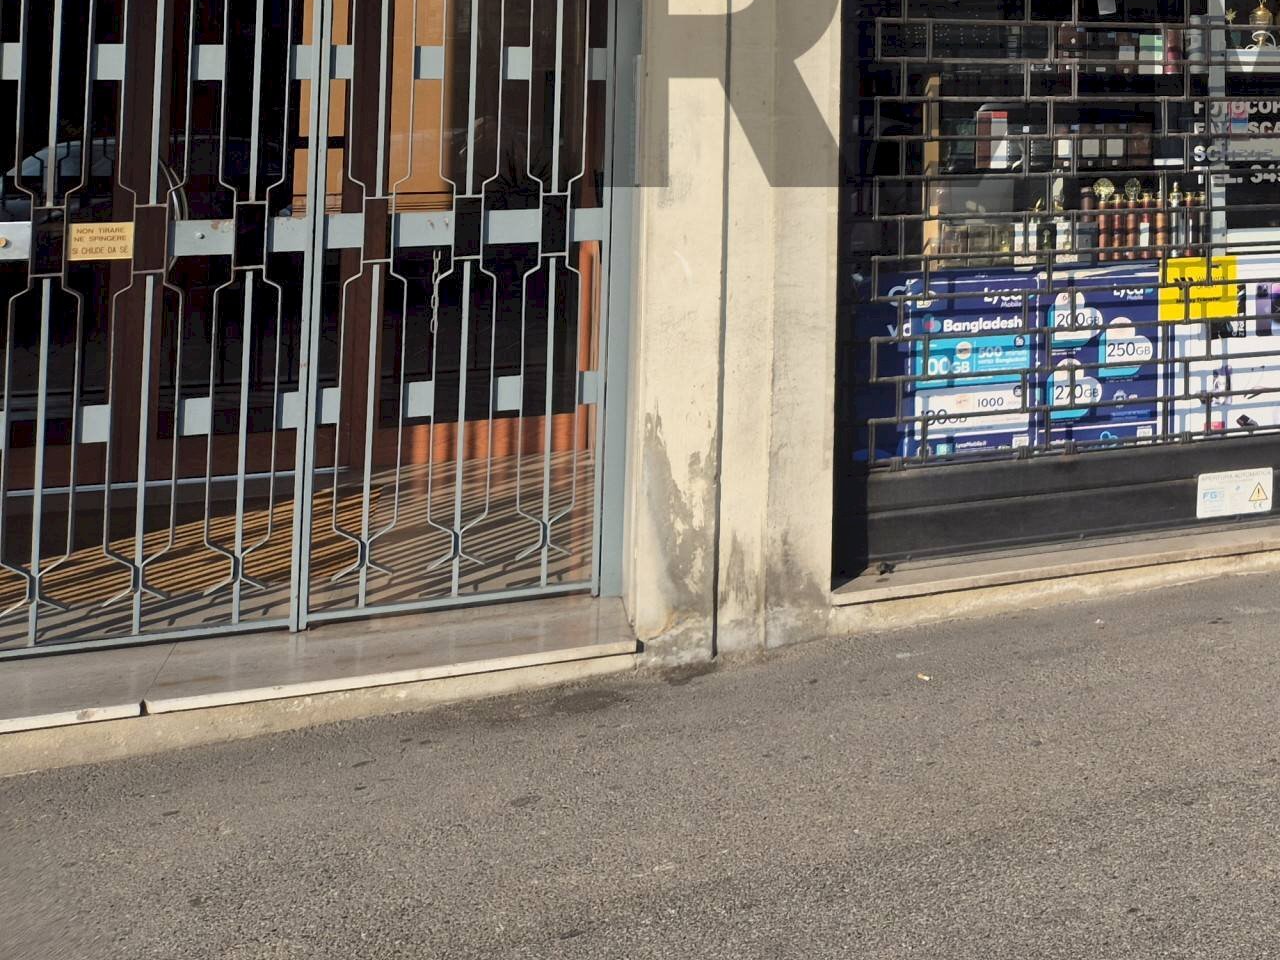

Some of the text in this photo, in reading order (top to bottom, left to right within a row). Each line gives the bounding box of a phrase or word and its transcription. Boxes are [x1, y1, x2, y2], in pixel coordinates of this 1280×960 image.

[943, 315, 1023, 334] Bangladesh
[1107, 341, 1151, 357] 250GB
[921, 354, 970, 375] 00GB
[978, 397, 1004, 408] 1000
